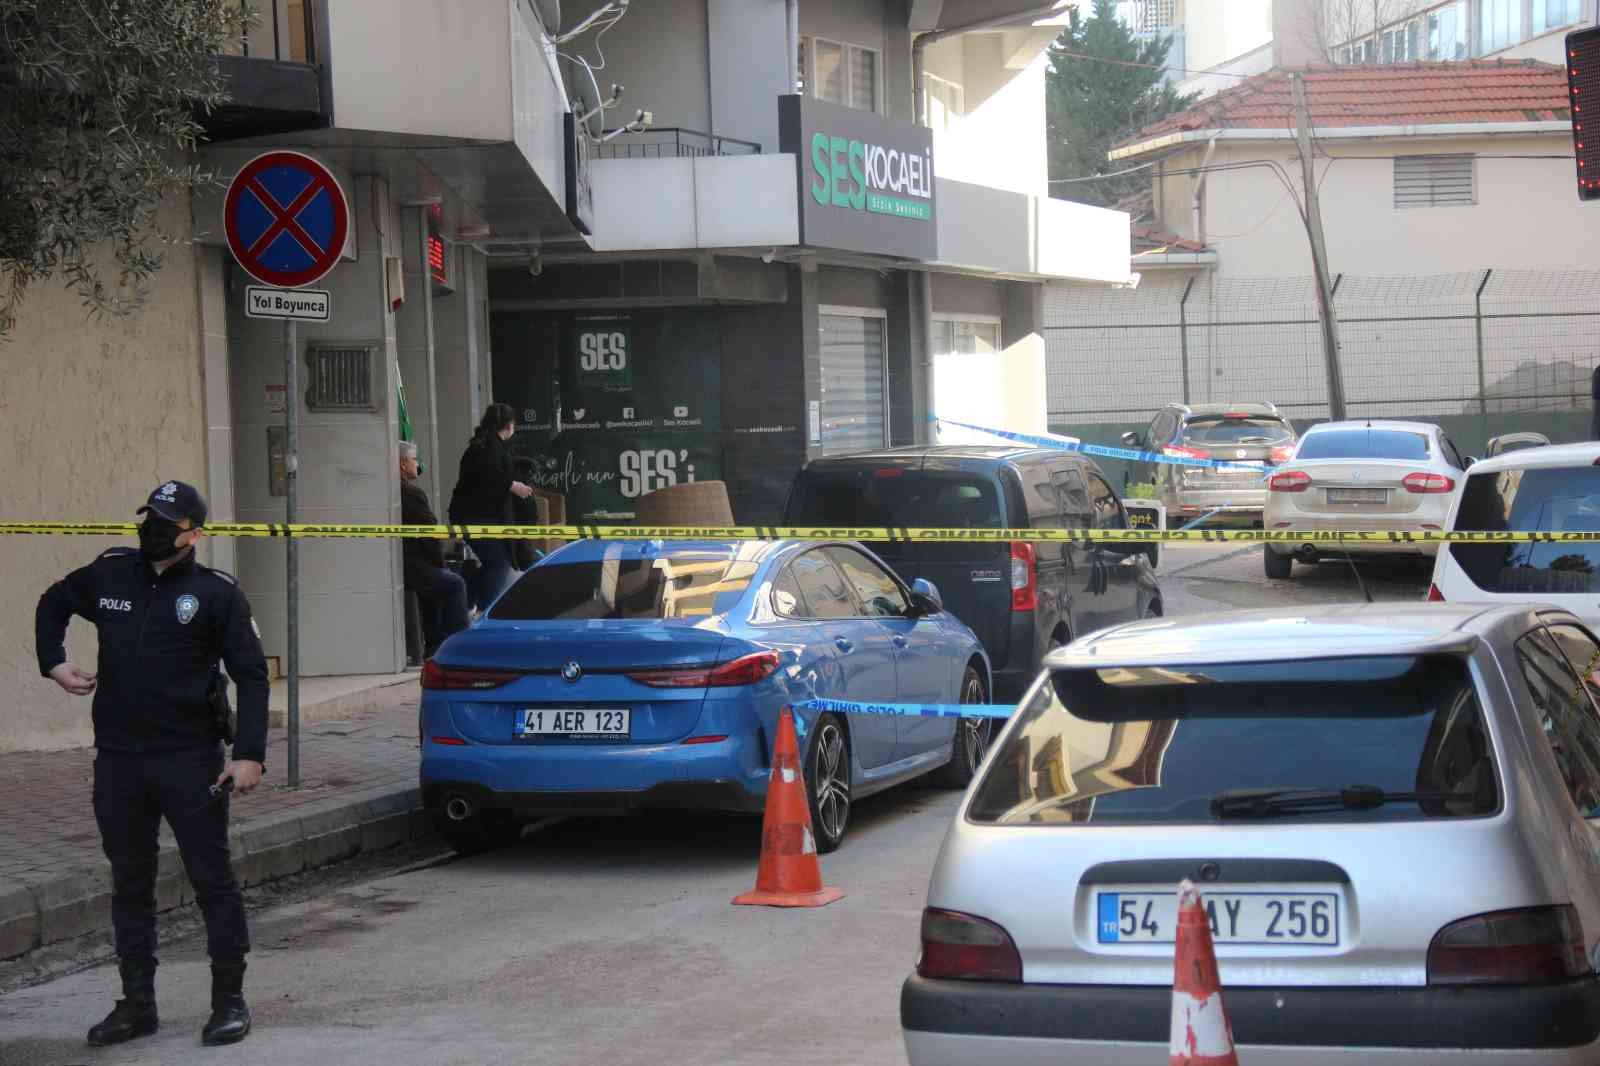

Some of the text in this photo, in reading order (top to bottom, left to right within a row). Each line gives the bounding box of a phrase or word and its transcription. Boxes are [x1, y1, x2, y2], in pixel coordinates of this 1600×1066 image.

[811, 133, 865, 210] SES
[254, 295, 325, 313] Yol Boyunca
[580, 332, 626, 371] SES
[99, 598, 132, 611] POLIS
[525, 711, 543, 731] 41
[553, 711, 585, 731] AER
[595, 711, 624, 731] 123
[1103, 922, 1118, 933] TR
[1120, 900, 1159, 936] 54
[1265, 900, 1330, 938] 256
